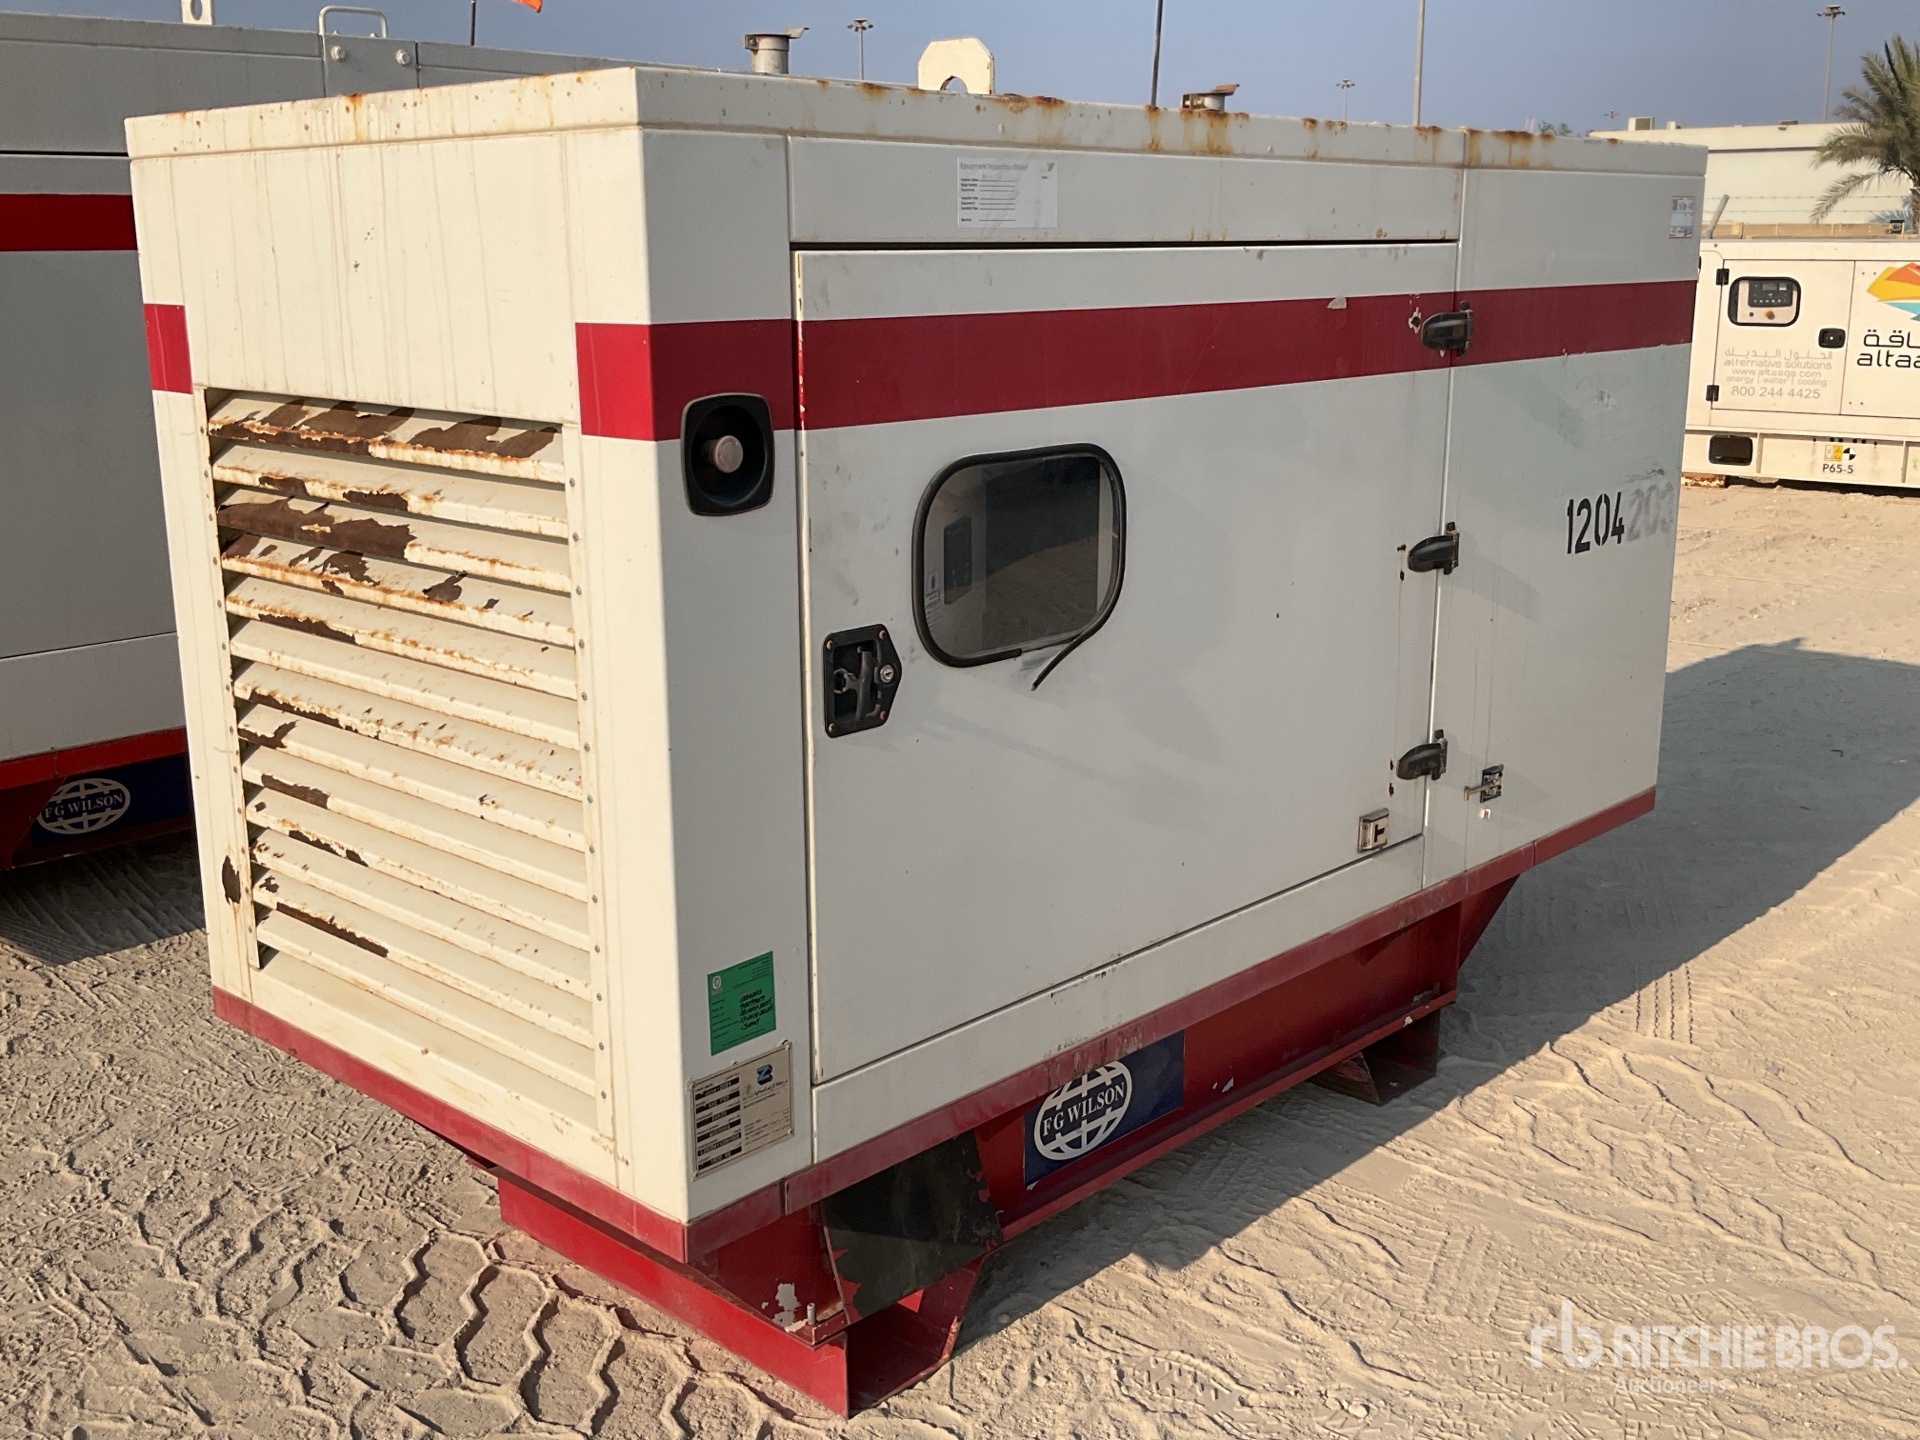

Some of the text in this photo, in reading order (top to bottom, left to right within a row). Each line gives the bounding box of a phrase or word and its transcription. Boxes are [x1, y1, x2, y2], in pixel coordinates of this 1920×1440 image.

[1723, 358, 1833, 371] alternative solutions
[1732, 368, 1822, 379] www.altaaqa.com
[1726, 375, 1828, 388] energy water cooling
[1731, 385, 1821, 399] 800 244 4425
[1822, 463, 1854, 474] P65-5
[44, 793, 123, 819] FG WILSON
[1042, 1081, 1126, 1137] FG WILSON
